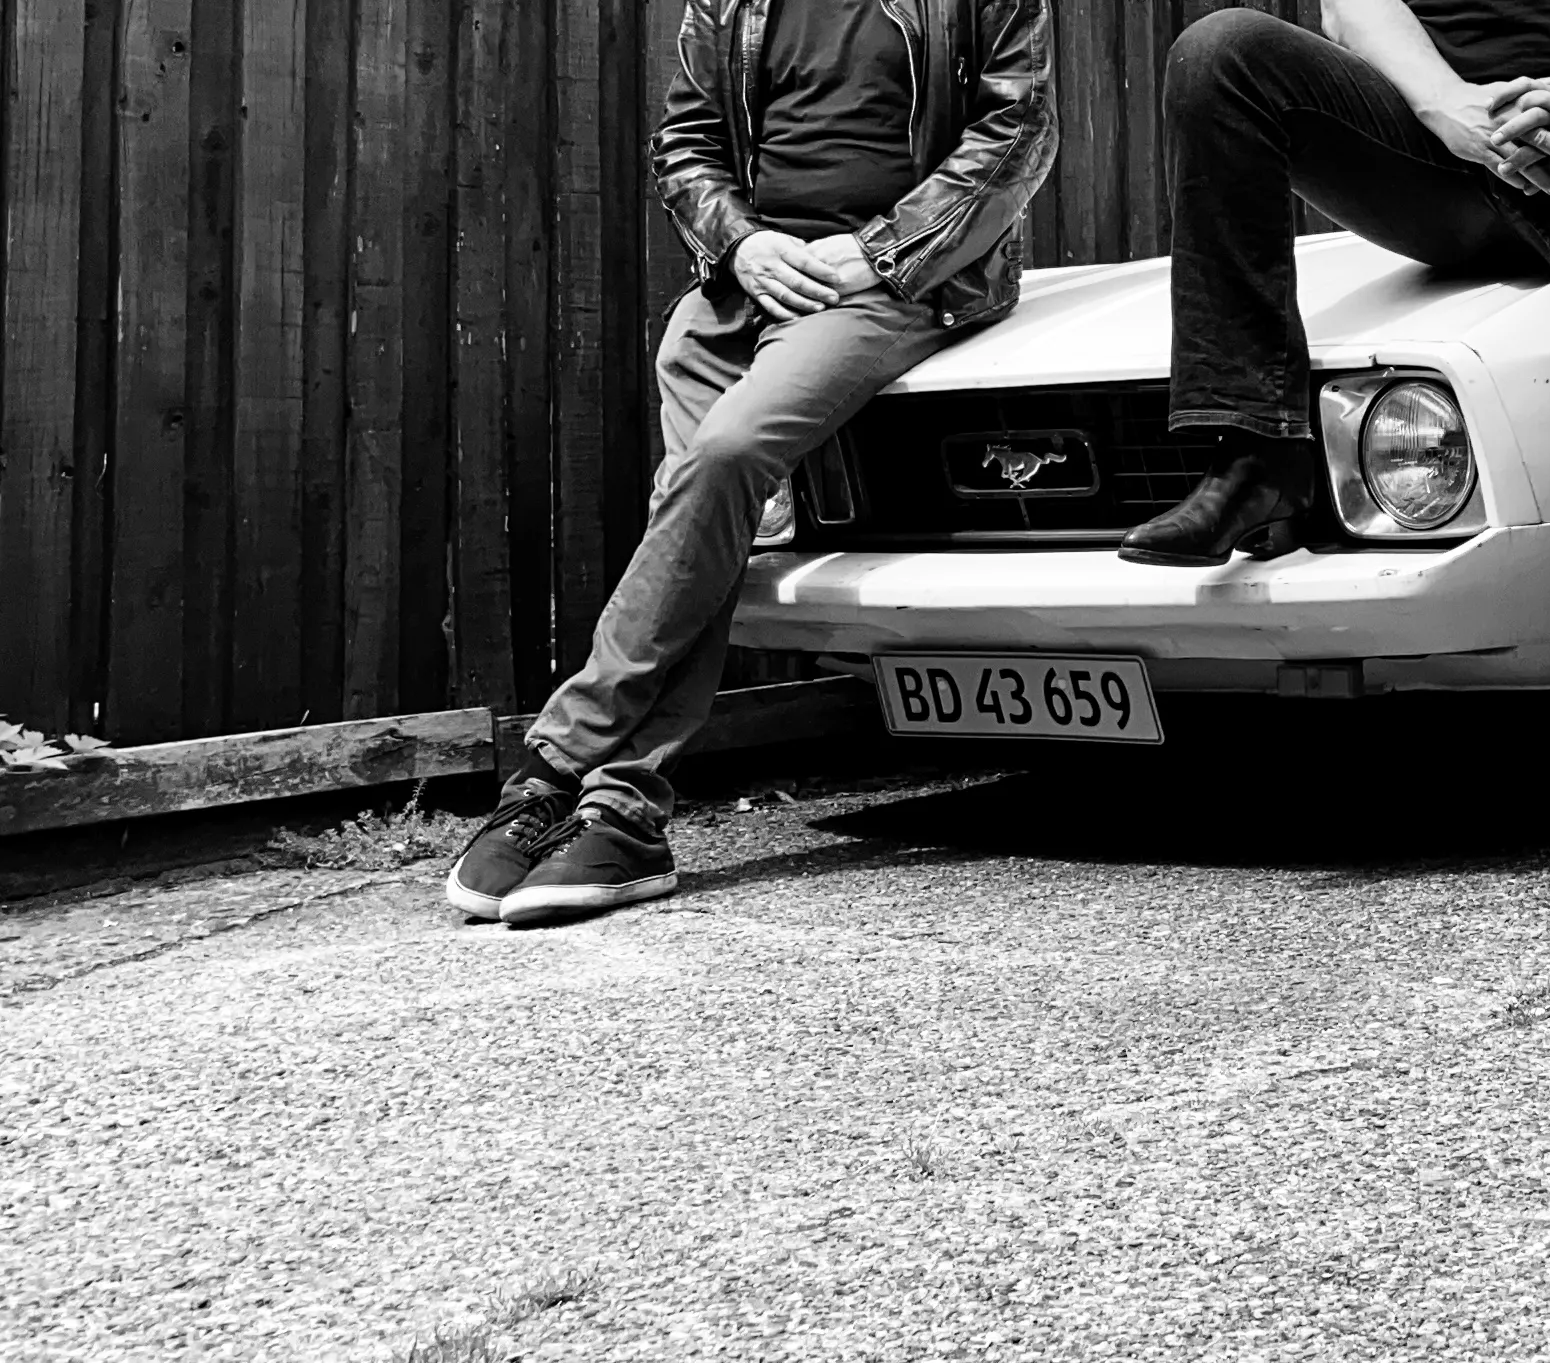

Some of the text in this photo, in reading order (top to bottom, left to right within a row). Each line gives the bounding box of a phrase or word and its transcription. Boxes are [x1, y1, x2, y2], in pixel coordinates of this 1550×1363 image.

[894, 666, 1131, 730] BD 43 659
